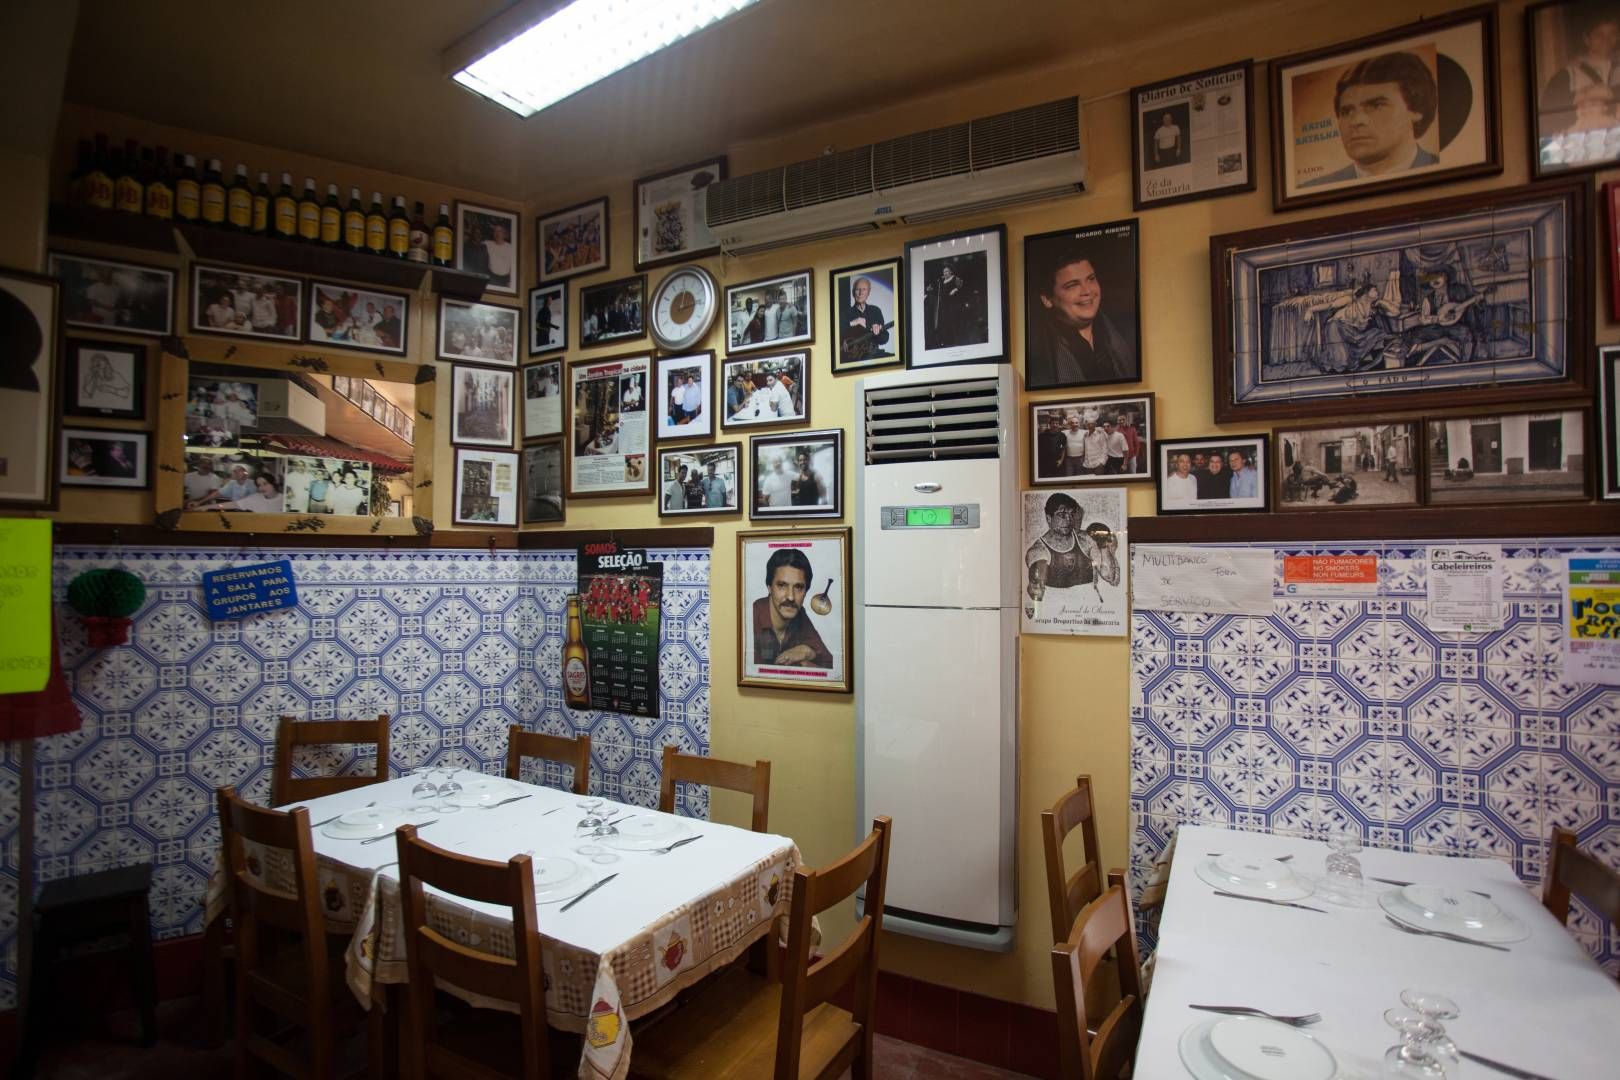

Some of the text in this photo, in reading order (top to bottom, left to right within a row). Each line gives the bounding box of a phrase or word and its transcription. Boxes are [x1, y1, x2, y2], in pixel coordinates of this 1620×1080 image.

[1075, 226, 1131, 239] RICARDO RIBEIRO
[584, 544, 618, 555] SOMOS
[598, 552, 643, 570] SELEÇÃO
[1329, 557, 1374, 565] FUMADORES
[1431, 562, 1493, 571] Cabeleireiros
[212, 566, 283, 583] RESERVAMOS
[227, 582, 256, 593] SALA
[263, 576, 289, 587] PARA
[212, 587, 290, 606] GRUPOS AOS
[226, 598, 283, 615] JANTARES
[567, 671, 586, 679] SAGRES
